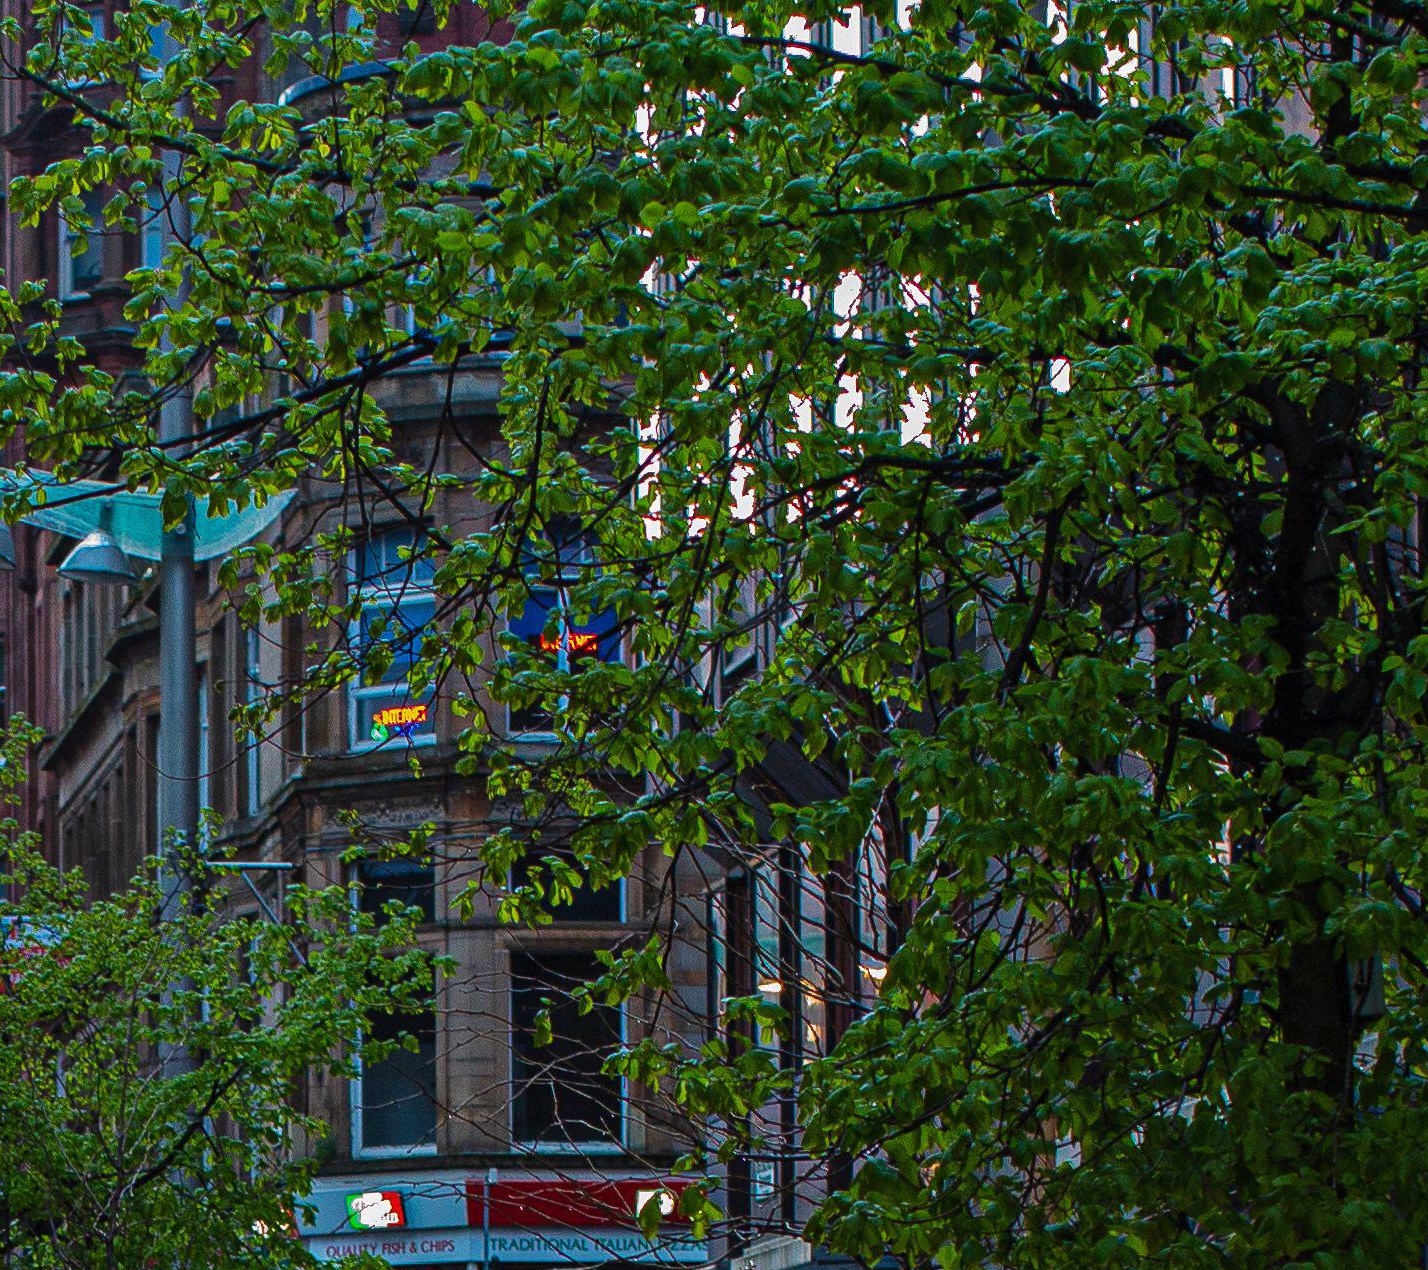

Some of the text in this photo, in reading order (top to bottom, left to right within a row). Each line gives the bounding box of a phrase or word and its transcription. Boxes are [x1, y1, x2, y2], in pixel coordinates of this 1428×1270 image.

[381, 1242, 407, 1255] FISH
[409, 1241, 417, 1254] &
[420, 1239, 455, 1254] CHIPS
[491, 1237, 589, 1252] TRADITIONAL
